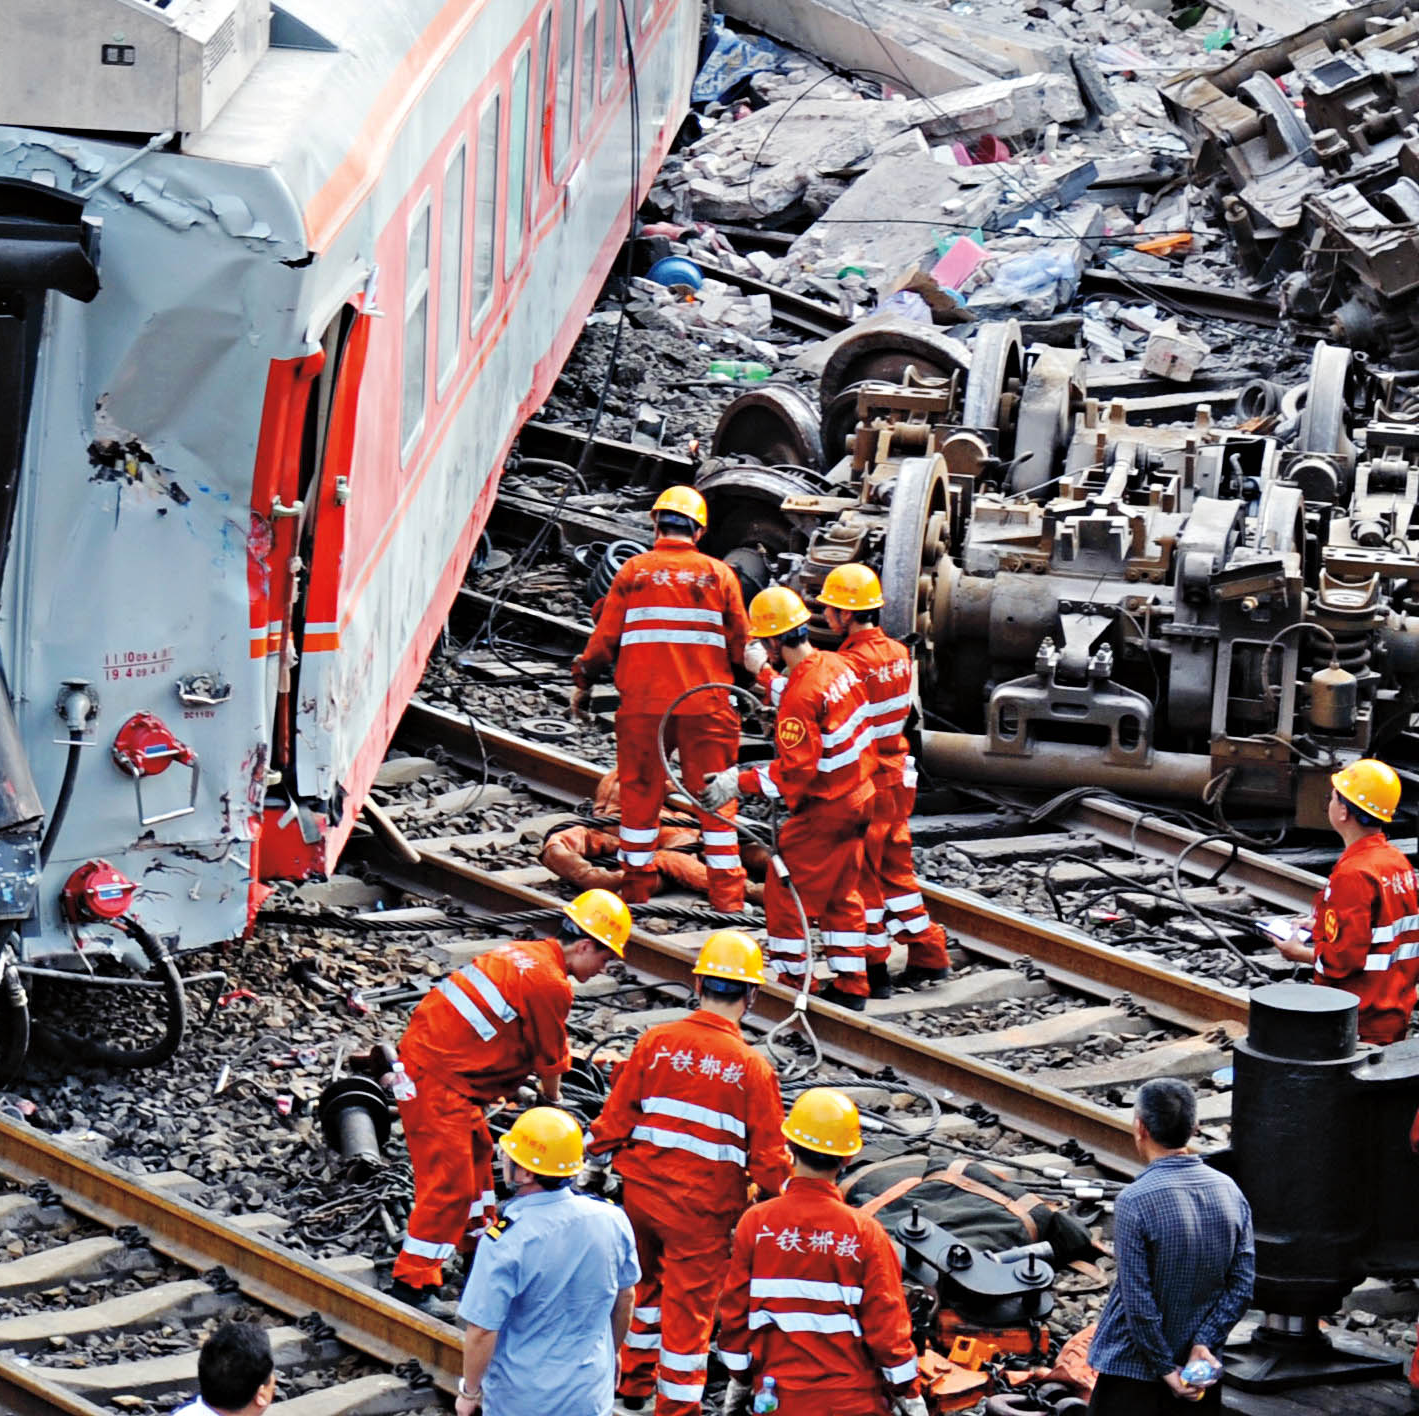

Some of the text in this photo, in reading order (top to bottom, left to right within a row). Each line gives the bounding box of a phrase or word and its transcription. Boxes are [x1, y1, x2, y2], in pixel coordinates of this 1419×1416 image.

[649, 1046, 746, 1091] 广铁郴救
[756, 1225, 862, 1264] 广铁郴救
